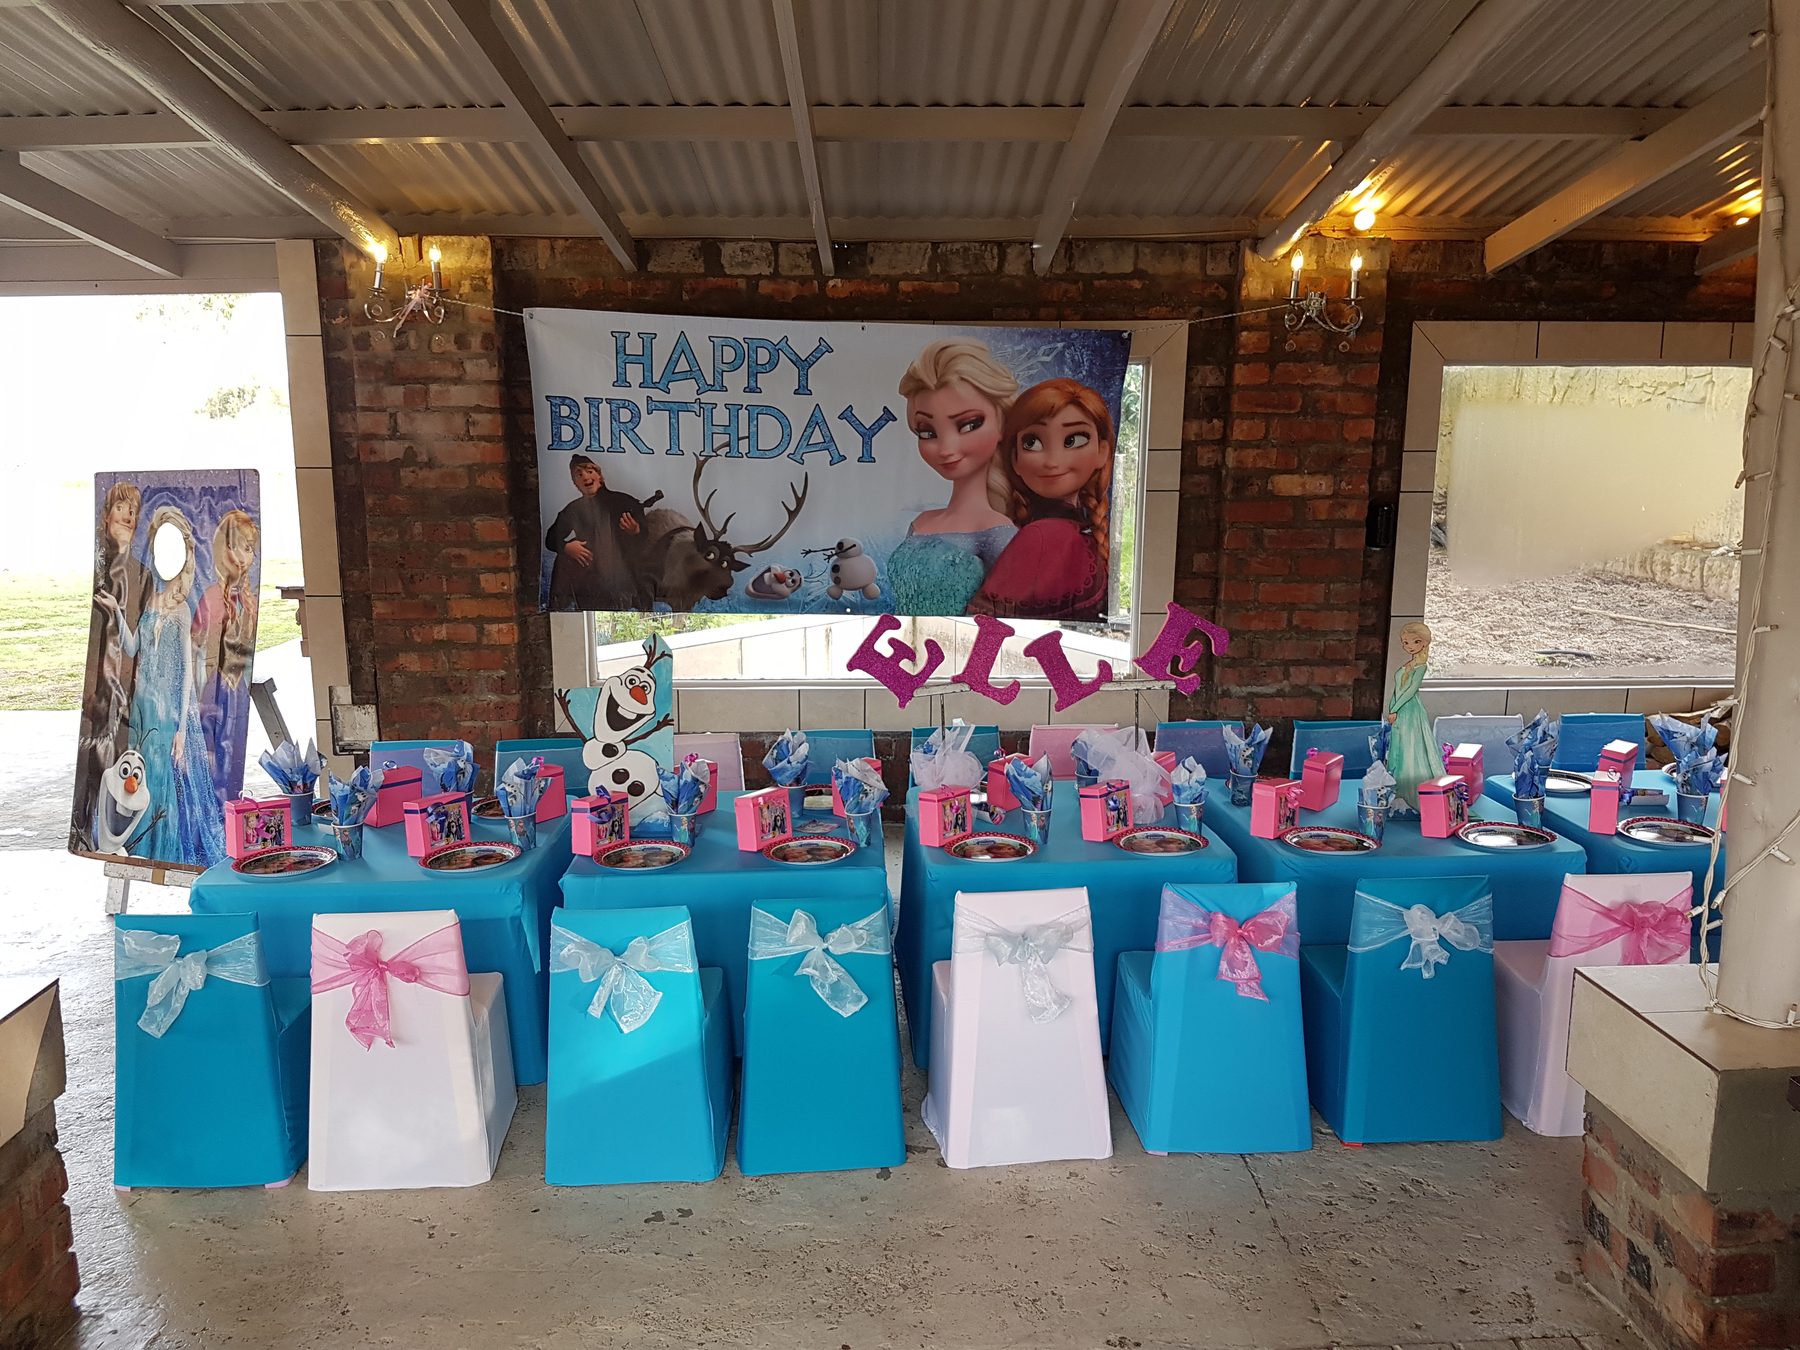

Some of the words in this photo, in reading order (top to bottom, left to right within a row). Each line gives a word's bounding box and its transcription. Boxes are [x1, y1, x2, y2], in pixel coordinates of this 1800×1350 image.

[611, 331, 834, 395] HAPPY
[546, 395, 898, 466] BIRTHDAY
[847, 602, 1230, 712] ELLE
